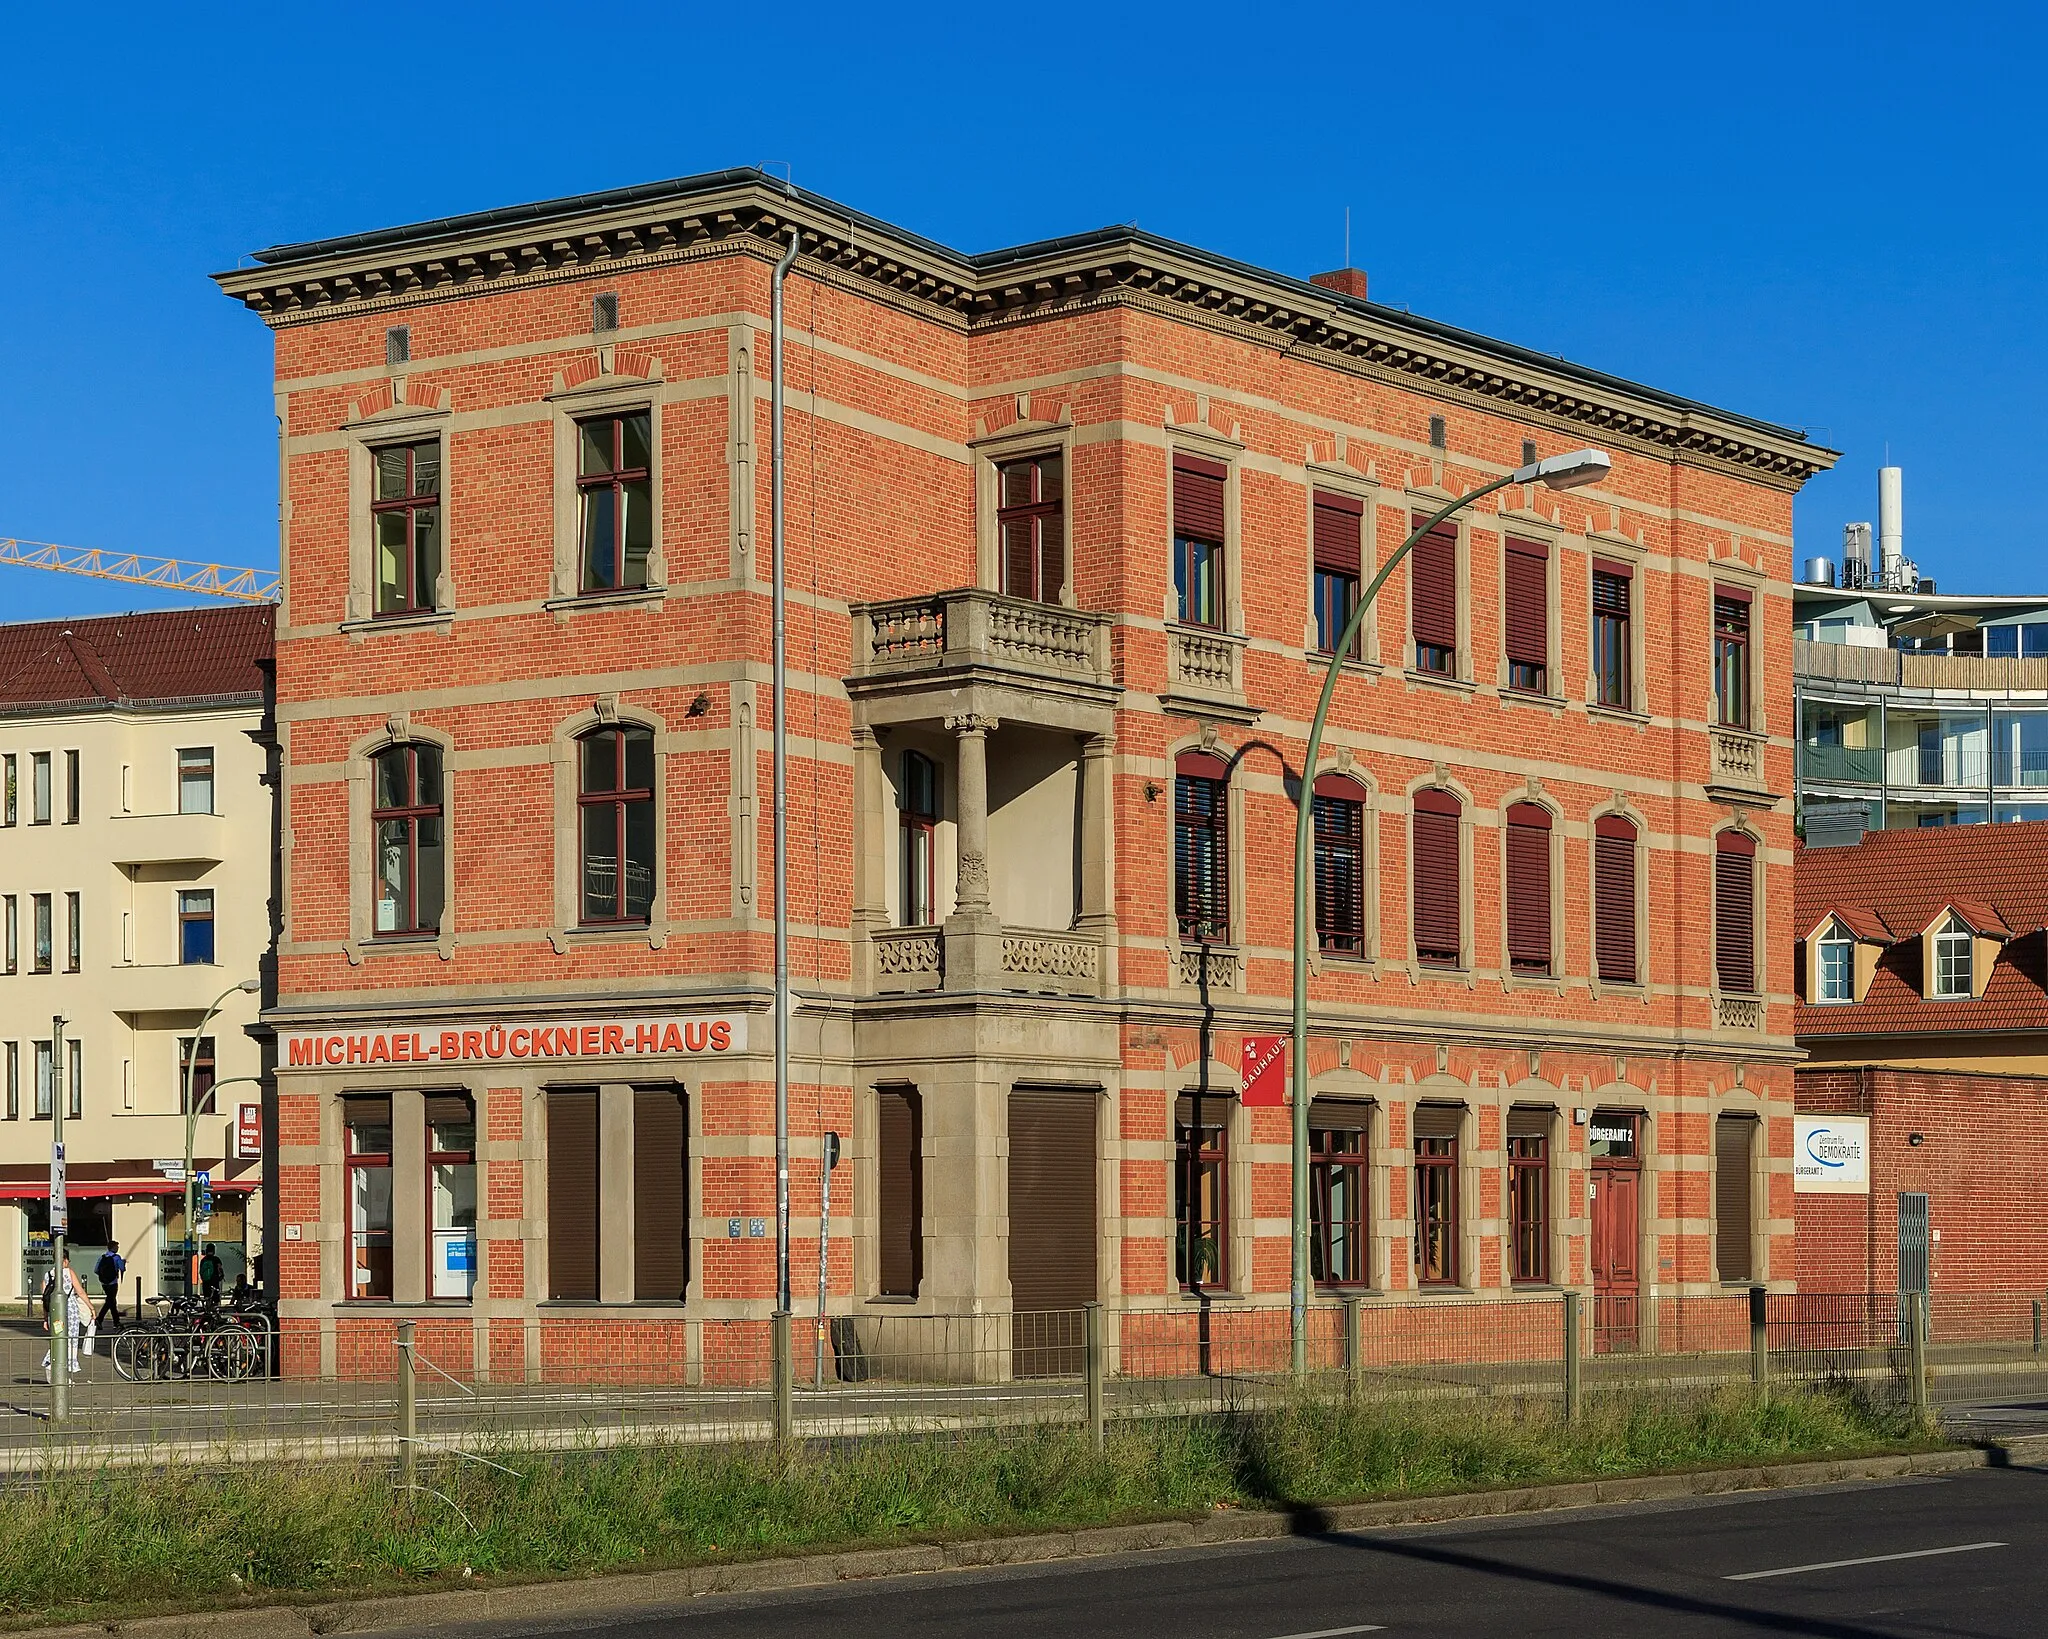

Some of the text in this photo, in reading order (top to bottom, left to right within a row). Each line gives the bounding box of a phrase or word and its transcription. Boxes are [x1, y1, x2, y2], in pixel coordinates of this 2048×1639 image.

[289, 1020, 731, 1066] MICHAEL-BRÜCKNER-HAUS
[1241, 1037, 1286, 1090] BAUHAUS
[1590, 1125, 1633, 1142] BÜRGERAMT 2
[1819, 1135, 1837, 1144] Zentrum
[1819, 1141, 1860, 1159] DEMOKRATIE
[1795, 1165, 1820, 1175] BÜRGERAMT
